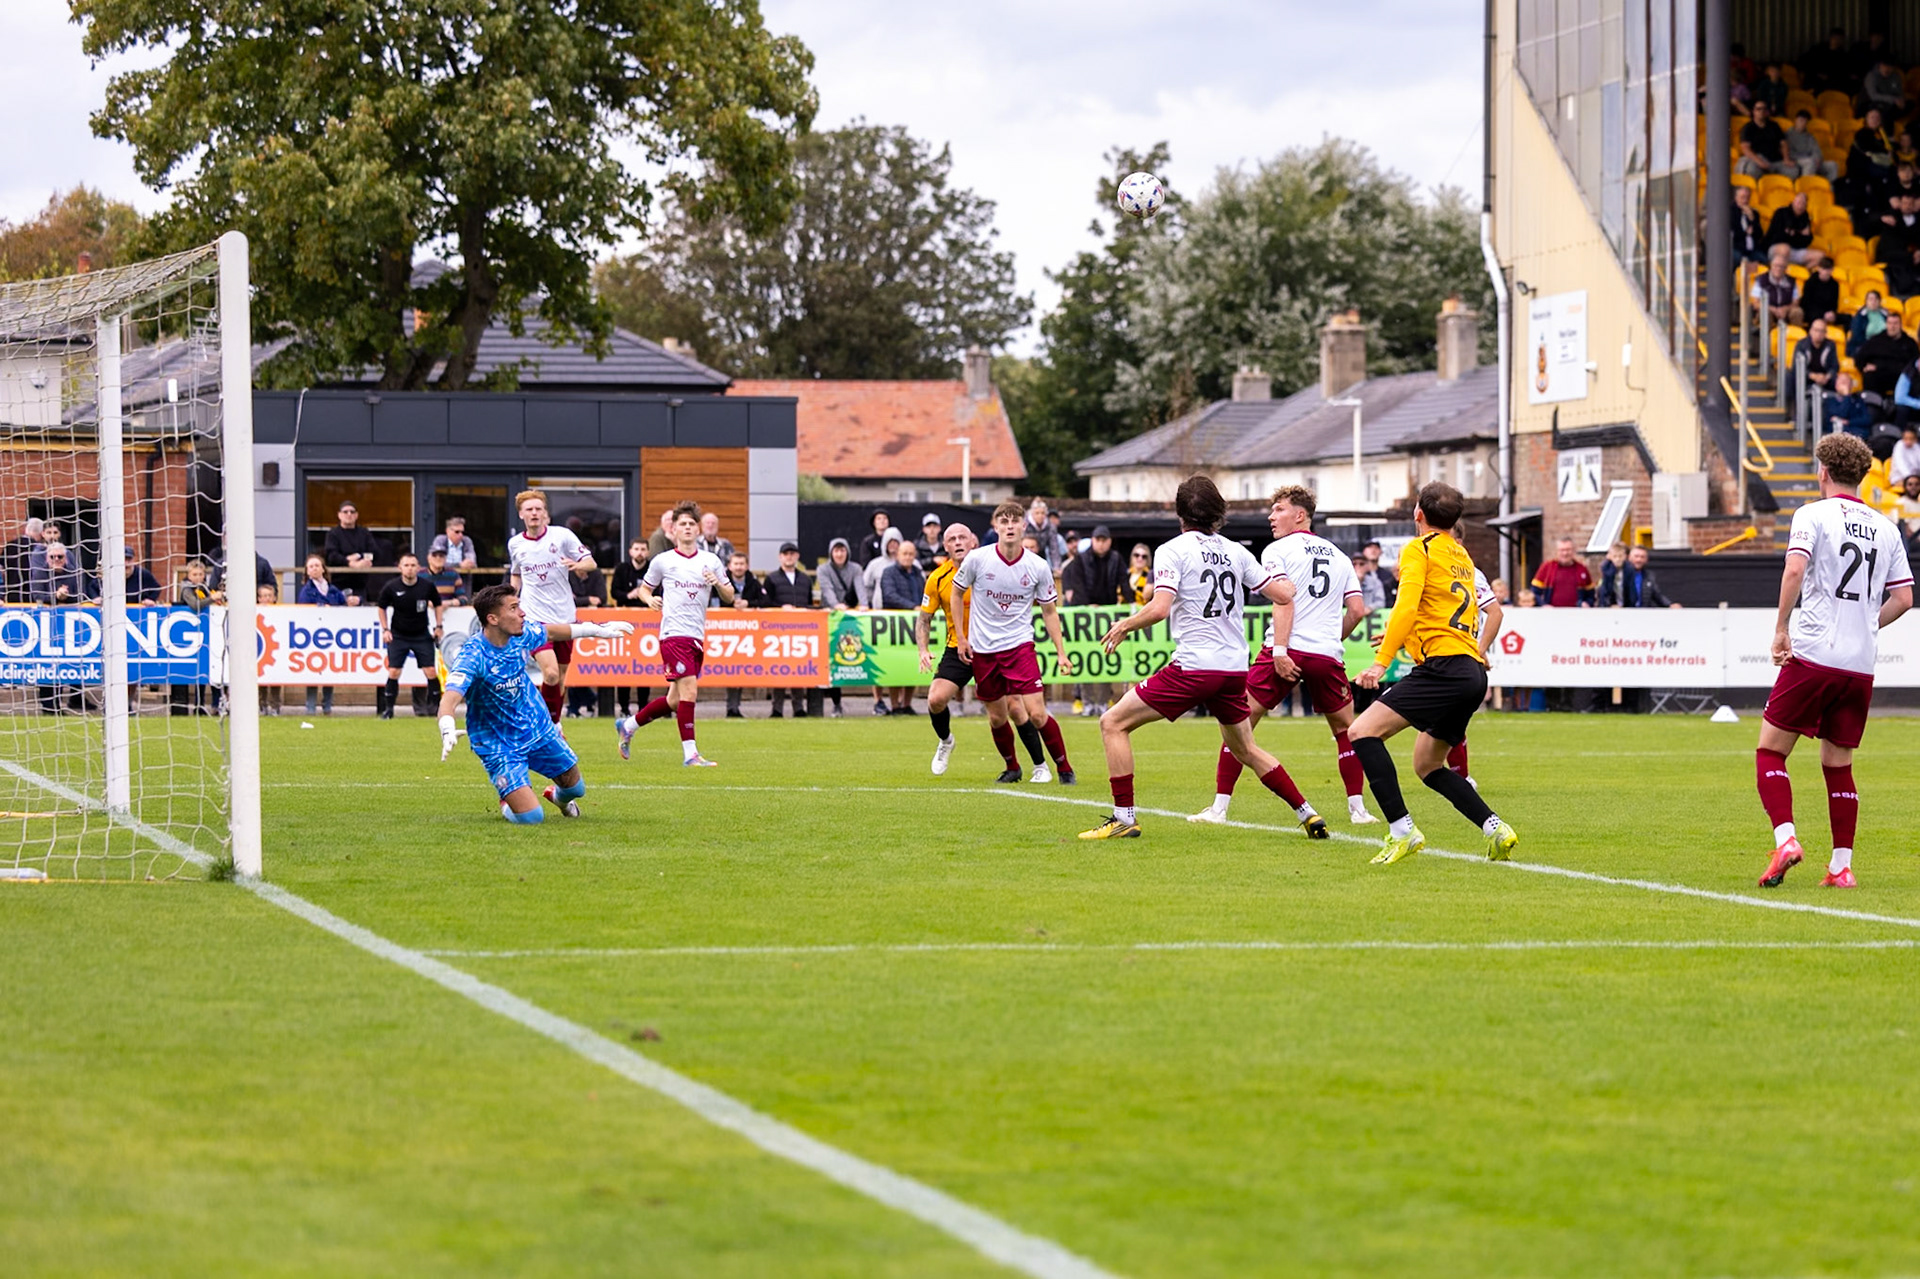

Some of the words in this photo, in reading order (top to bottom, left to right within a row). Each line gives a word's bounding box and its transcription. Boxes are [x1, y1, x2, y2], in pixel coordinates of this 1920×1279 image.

[1845, 522, 1877, 542] KELLY
[1304, 546, 1335, 557] MORSE
[1308, 558, 1330, 598] 5
[1835, 542, 1877, 603] 21
[986, 589, 1024, 601] Pulman
[1200, 569, 1236, 618] 29
[0, 611, 204, 657] OLDNG
[289, 621, 392, 650] beari
[705, 620, 759, 630] GINEERING
[761, 621, 819, 632] Components
[575, 636, 631, 657] Call:
[707, 635, 756, 658] 374
[763, 635, 819, 658] 2151
[1505, 635, 1520, 650] 5
[1580, 638, 1608, 648] Real
[1612, 638, 1656, 651] Money
[1660, 637, 1678, 648] for
[288, 652, 389, 673] sourc
[578, 660, 818, 680] www.beasource.co.uk
[1551, 655, 1580, 665] Real
[1584, 655, 1642, 665] Business
[1646, 654, 1707, 666] Referrals
[834, 672, 868, 680] SPONSOR
